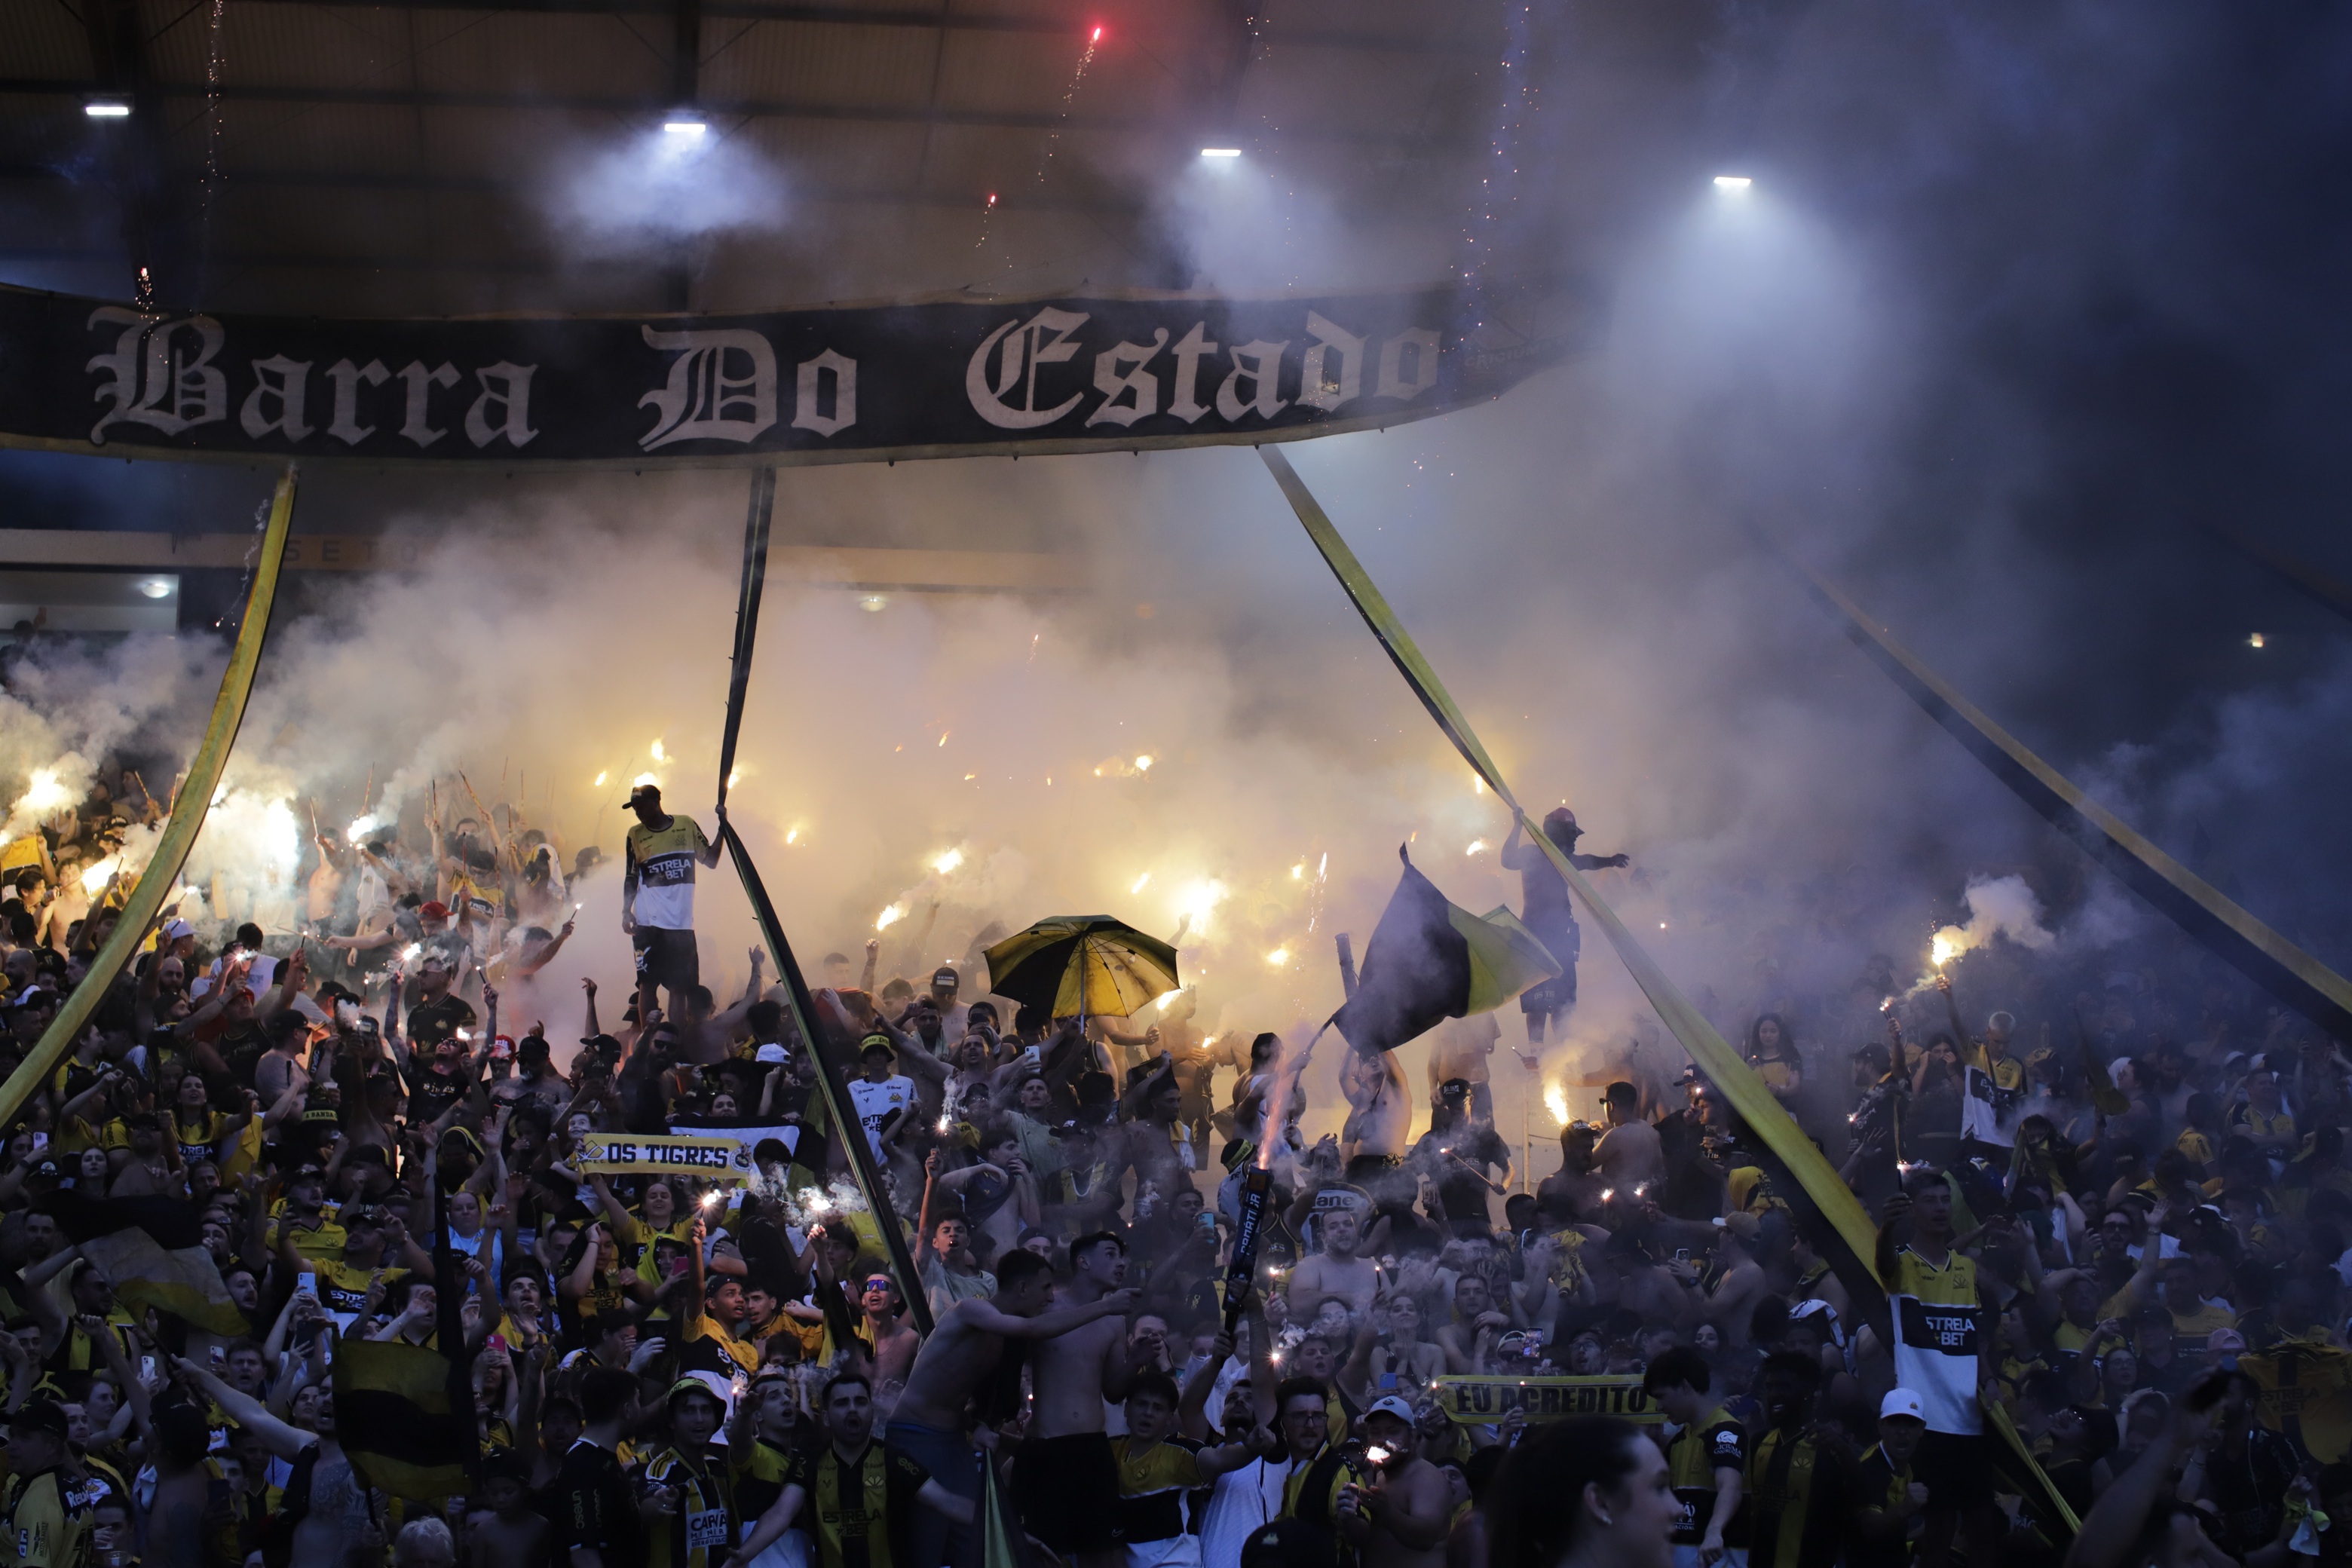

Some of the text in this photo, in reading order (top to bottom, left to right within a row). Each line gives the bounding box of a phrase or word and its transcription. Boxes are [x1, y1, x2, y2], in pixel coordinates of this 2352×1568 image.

[85, 306, 1441, 452] Barra Do Estado
[648, 859, 692, 874] ESTRELA
[664, 868, 685, 880] BET
[608, 1142, 637, 1164] OS
[645, 1144, 730, 1169] TIGRES
[1940, 1331, 1965, 1346] BET
[1454, 1385, 1648, 1413] EU ACREDITO
[2280, 1399, 2308, 1413] BET
[572, 1490, 585, 1530] unesc
[822, 1508, 883, 1524] ESTRELA
[845, 1522, 871, 1536] BET
